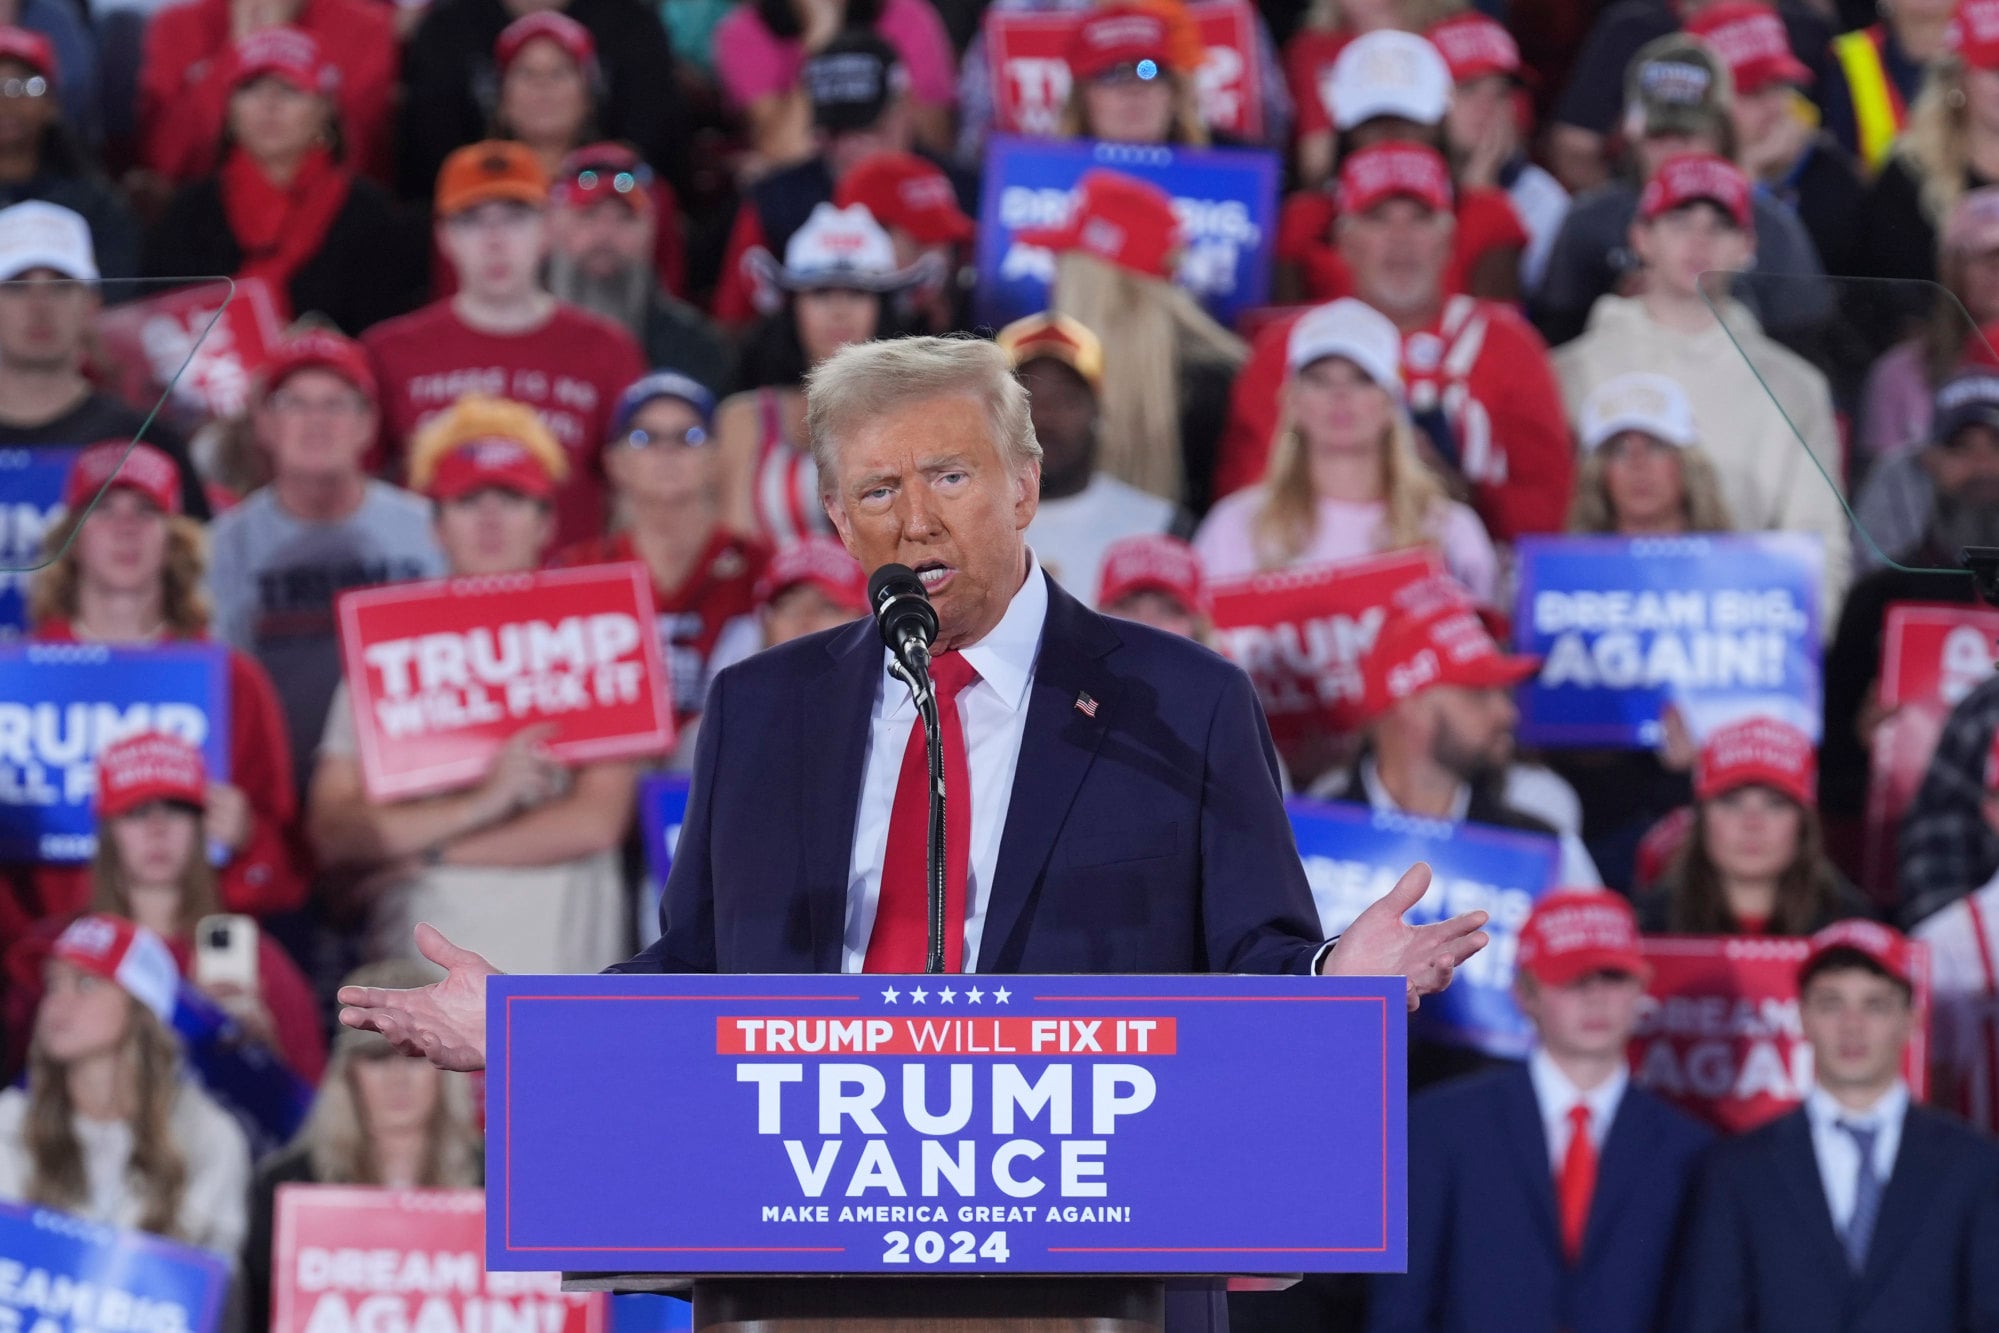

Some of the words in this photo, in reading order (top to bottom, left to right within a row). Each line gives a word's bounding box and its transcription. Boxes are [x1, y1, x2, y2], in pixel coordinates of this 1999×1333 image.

[1535, 590, 1706, 633] DREAM
[1710, 589, 1809, 637] BIG,
[365, 612, 640, 698] TRUMP
[1541, 632, 1786, 689] AGAIN!
[377, 685, 501, 738] WILL
[505, 664, 590, 717] FIX
[737, 1020, 893, 1052] TRUMP
[906, 1020, 1016, 1052] WILL
[1031, 1020, 1103, 1052] FIX
[1116, 1020, 1157, 1052] IT
[736, 1063, 1157, 1135] TRUMP
[783, 1139, 1107, 1198] VANCE
[762, 1206, 829, 1222] MAKE
[838, 1206, 949, 1222] AMERICA
[958, 1206, 1037, 1222] GREAT
[1045, 1206, 1131, 1223] AGAIN!
[298, 1247, 479, 1294] DREAM
[882, 1230, 1010, 1263] 2024
